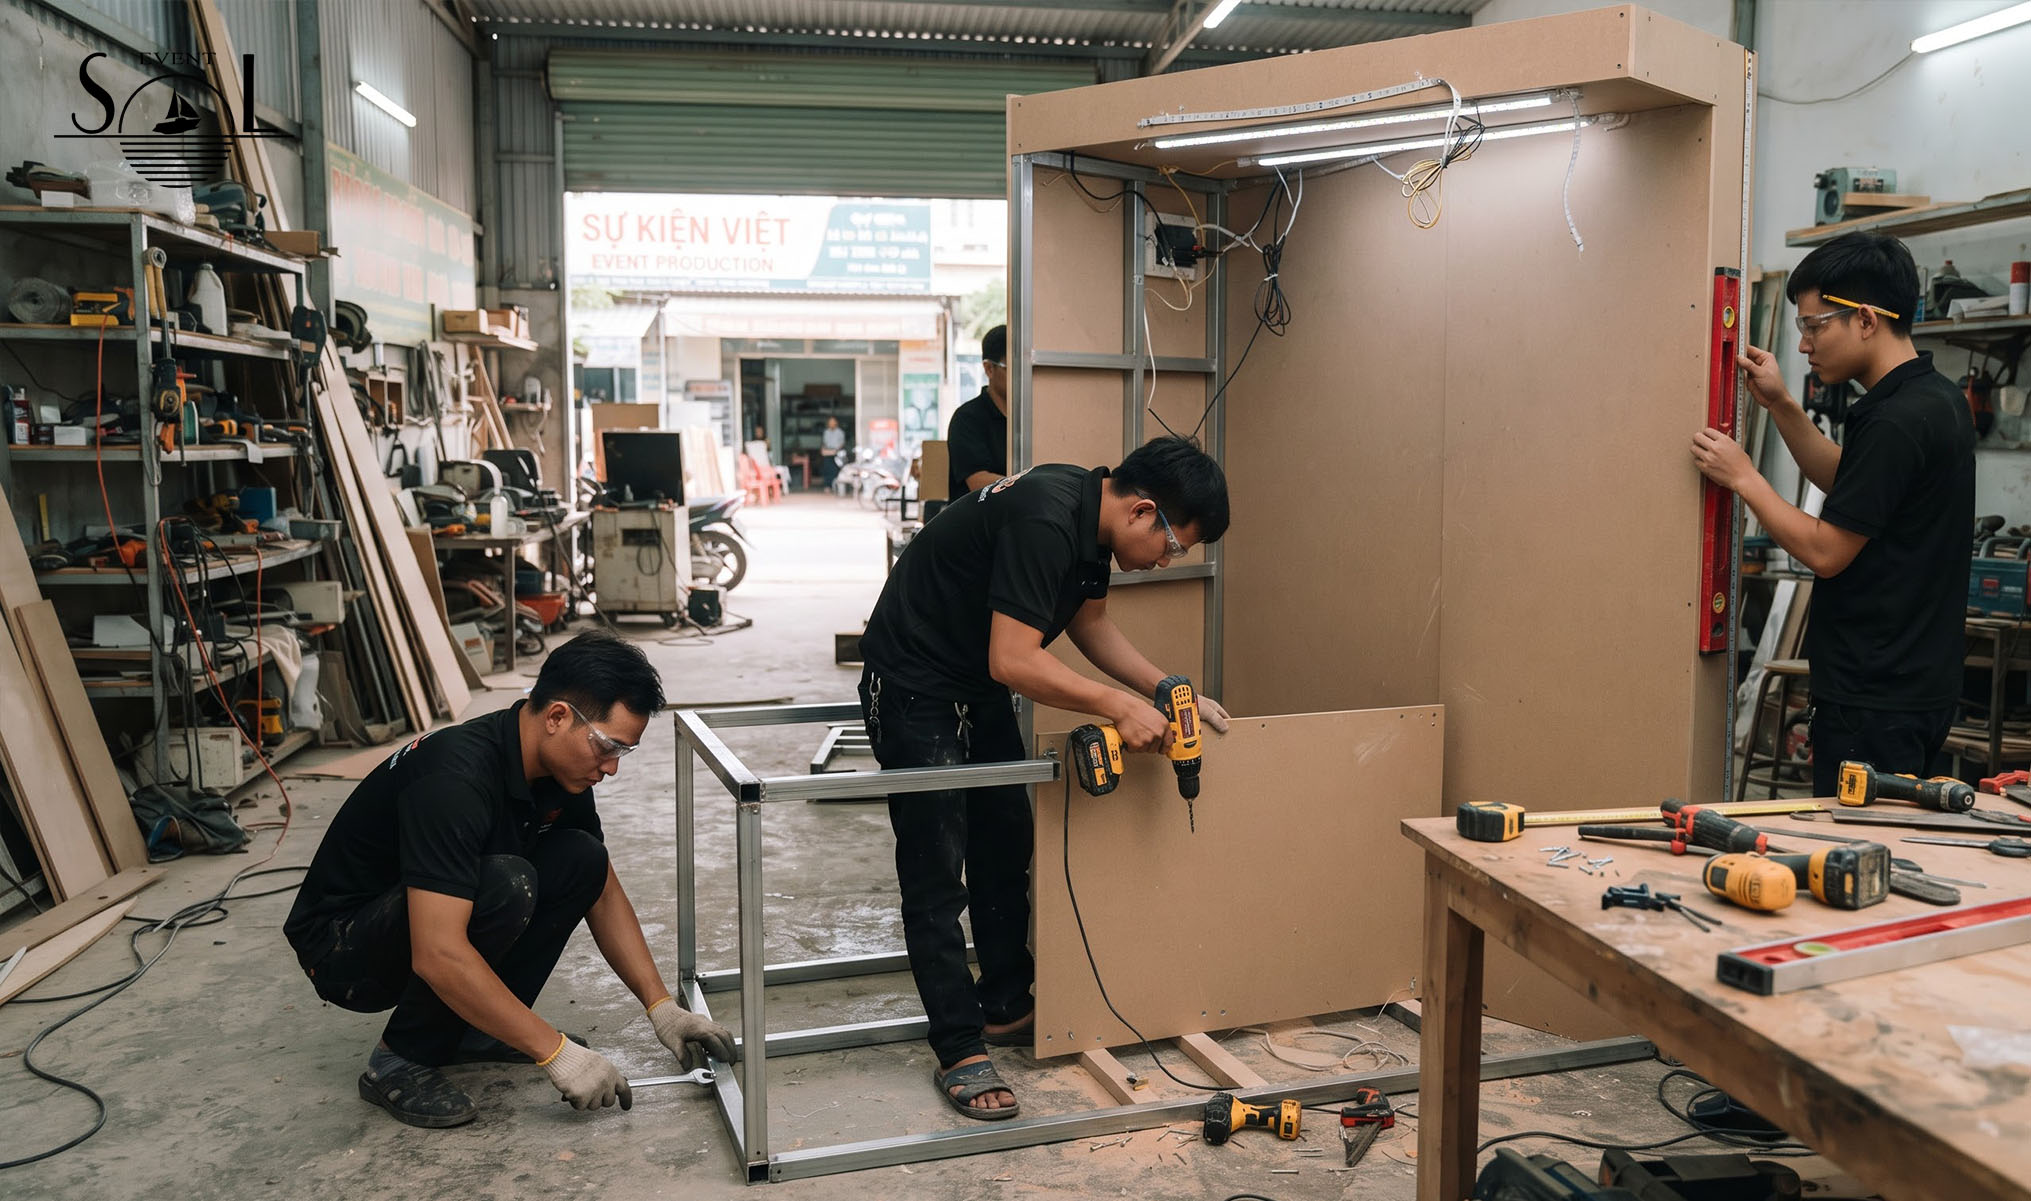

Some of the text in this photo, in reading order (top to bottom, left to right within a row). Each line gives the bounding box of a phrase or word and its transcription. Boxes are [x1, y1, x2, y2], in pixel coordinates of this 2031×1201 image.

[582, 207, 791, 252] SỰ KIỆN VIỆT
[591, 253, 774, 273] EVENT PRODUCTION
